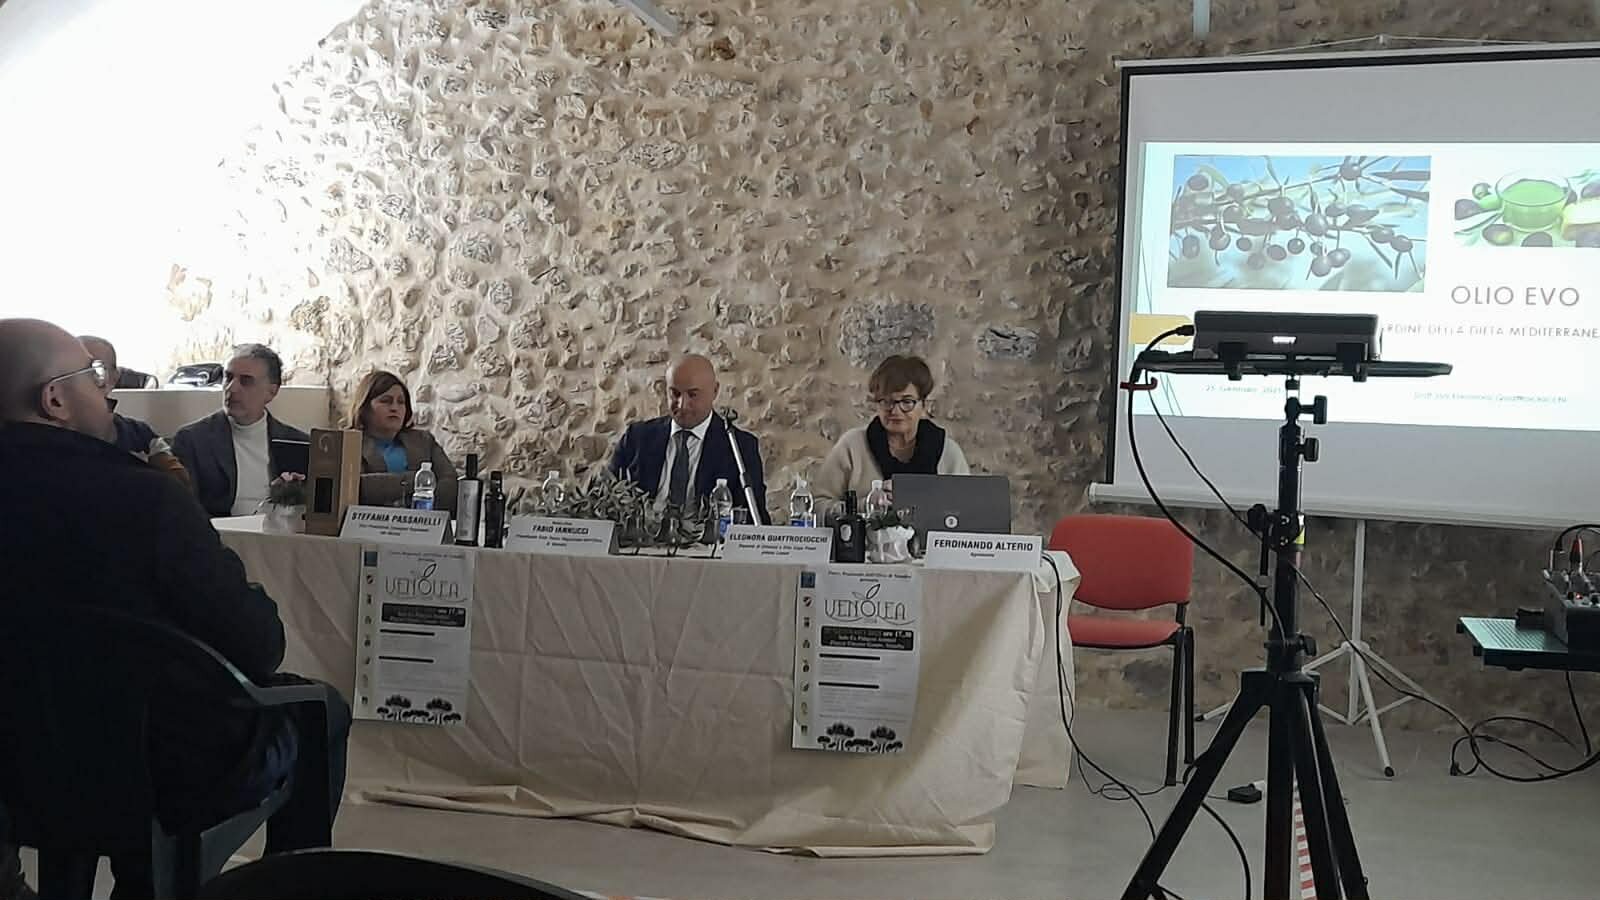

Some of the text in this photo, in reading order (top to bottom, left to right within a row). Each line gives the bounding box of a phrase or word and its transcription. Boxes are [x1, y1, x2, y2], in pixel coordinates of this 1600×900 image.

[1450, 285, 1580, 307] OLIO EVO
[1386, 323, 1423, 336] RDINE
[1469, 325, 1504, 336] DIETA
[1508, 326, 1600, 339] MEDITERRANE
[351, 511, 442, 526] STEFANIA PASSARELLI
[532, 524, 554, 534] FABIO
[729, 533, 828, 544] ELEONORA QUATTROCIOCCHI
[933, 538, 1033, 552] FERDINANDO ALTERIO
[824, 599, 906, 621] VENOLEA
